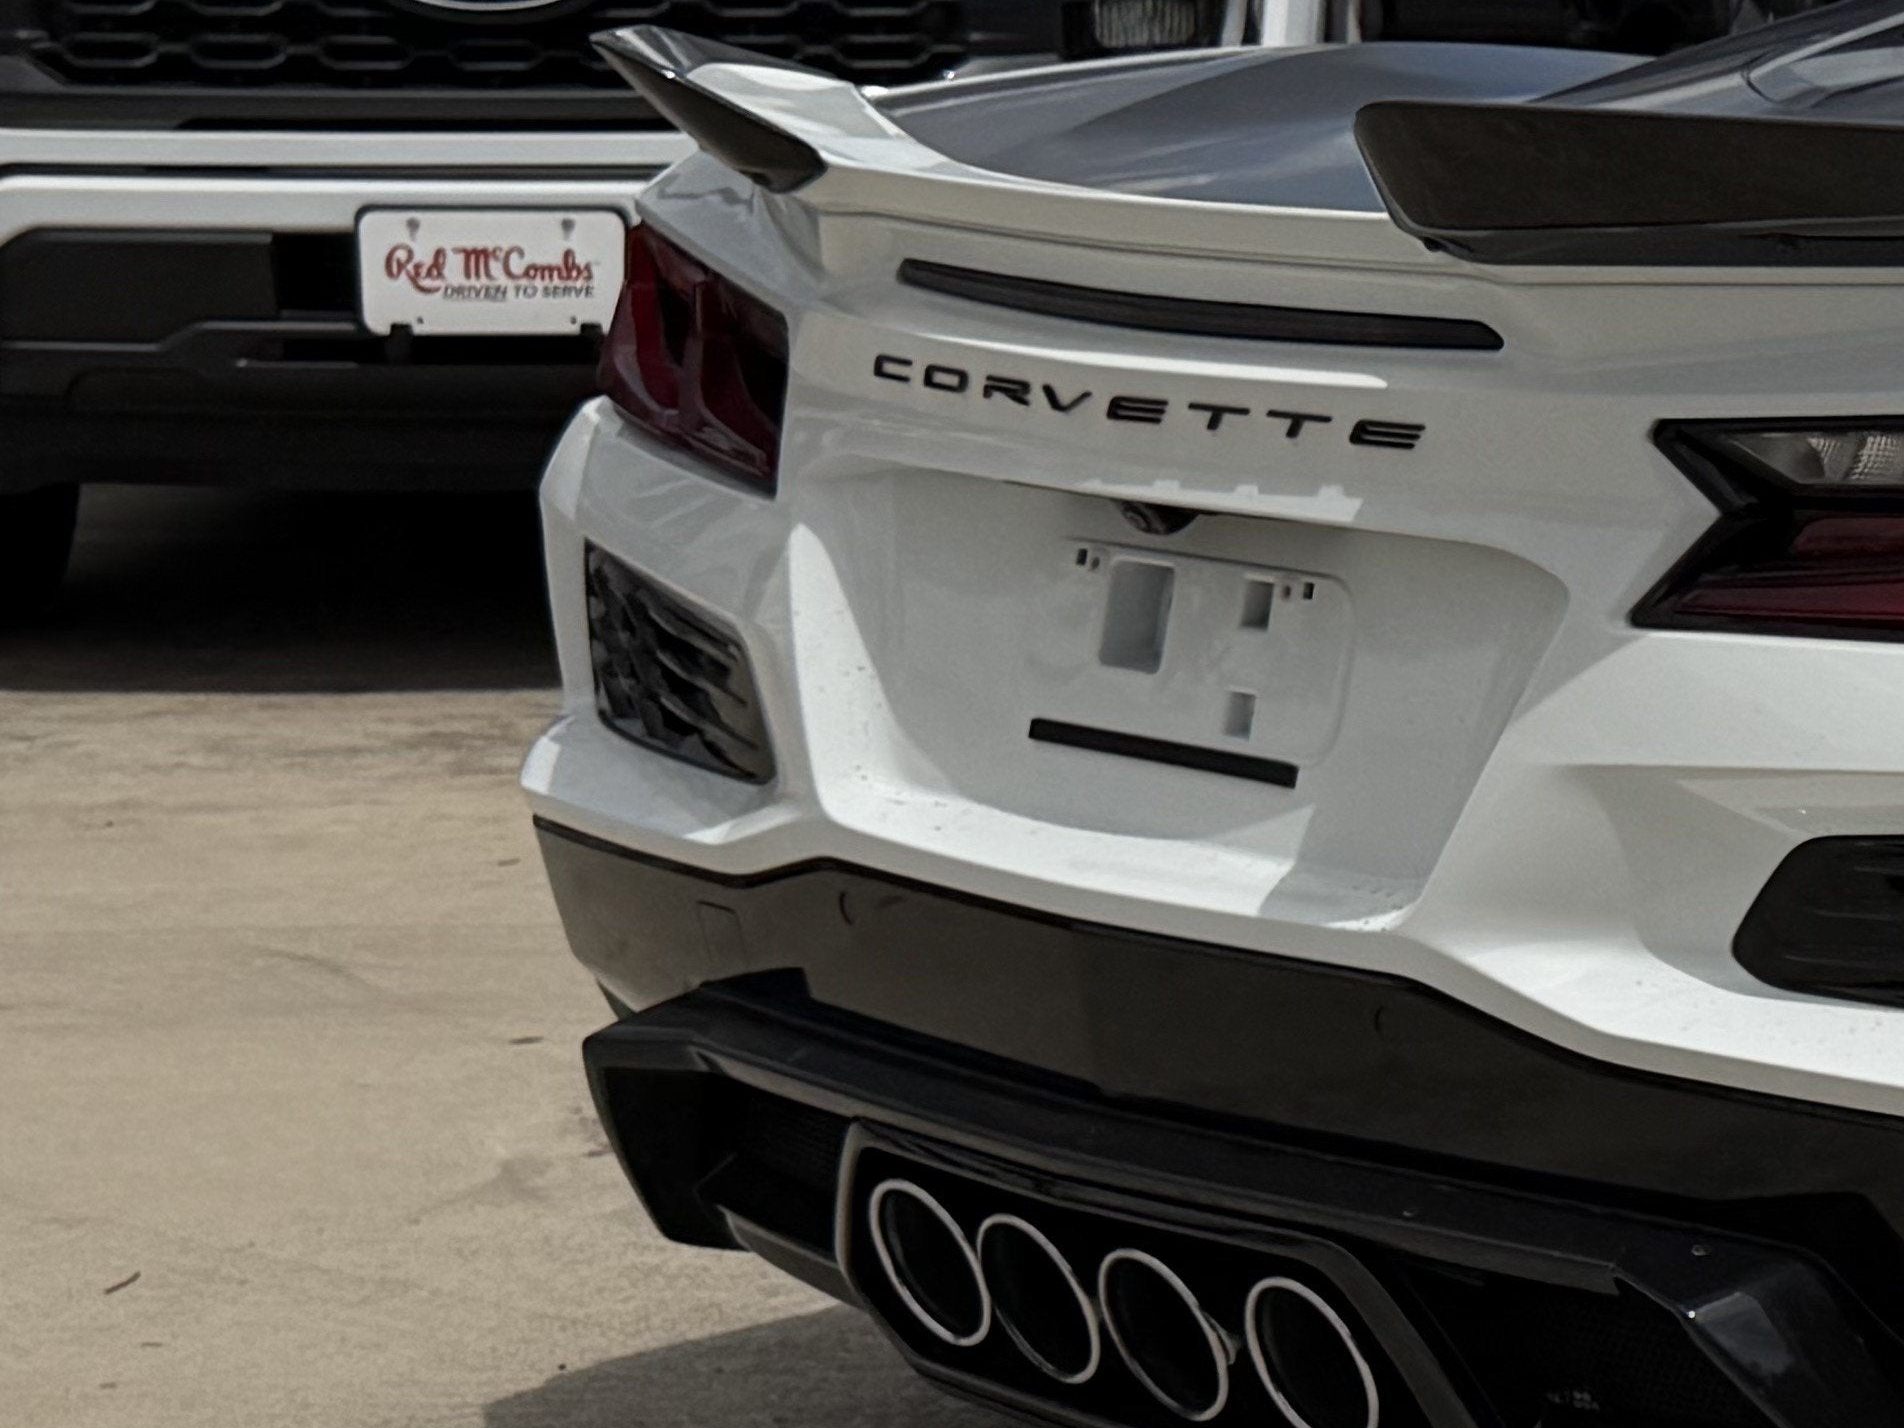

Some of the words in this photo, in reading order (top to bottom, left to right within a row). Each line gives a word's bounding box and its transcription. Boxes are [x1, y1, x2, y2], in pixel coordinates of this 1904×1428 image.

[385, 243, 447, 294] Red
[451, 245, 594, 282] McCombs
[443, 285, 508, 302] DRIVEN
[513, 285, 539, 299] TO
[541, 285, 595, 299] SERVE
[873, 354, 1427, 451] CORVETTE
